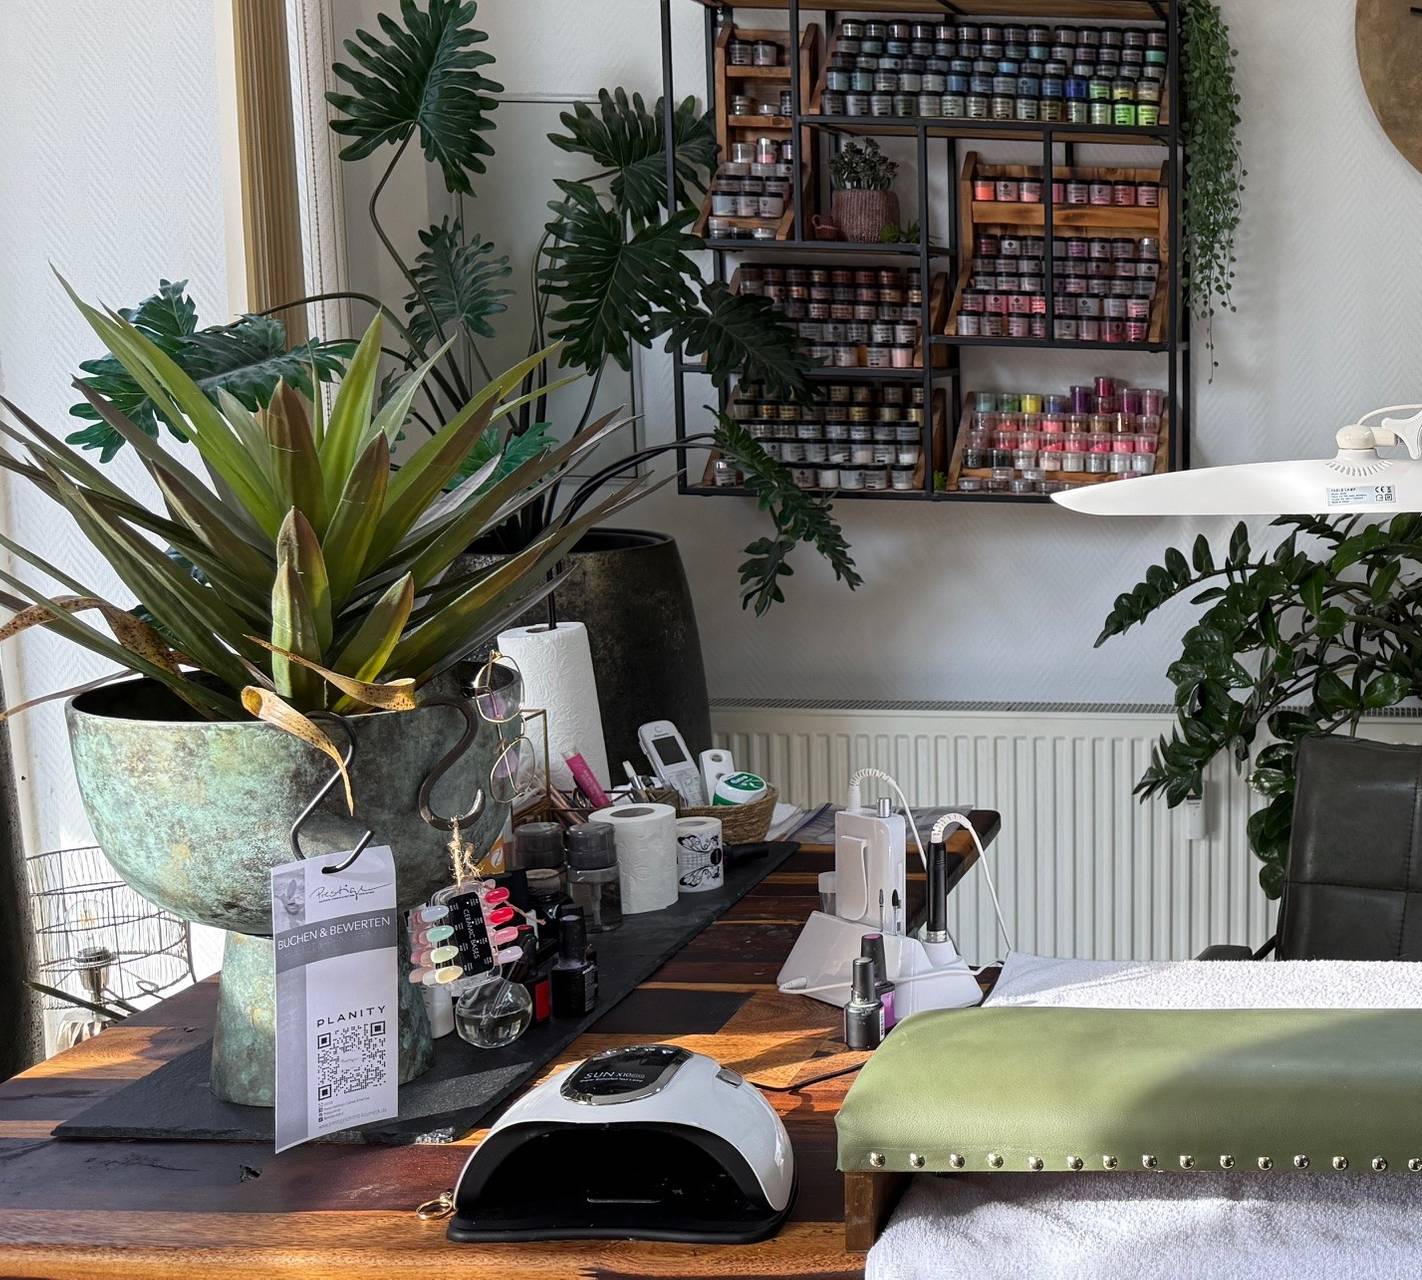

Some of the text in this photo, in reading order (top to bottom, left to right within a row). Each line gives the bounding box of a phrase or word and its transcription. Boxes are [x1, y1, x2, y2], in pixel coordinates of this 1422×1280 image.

[277, 916, 391, 951] BUCHEN & BEWERTEN
[463, 908, 476, 942] CERAMIC
[470, 939, 481, 960] BASES
[316, 1005, 387, 1028] PLANITY
[584, 1071, 615, 1079] SUN
